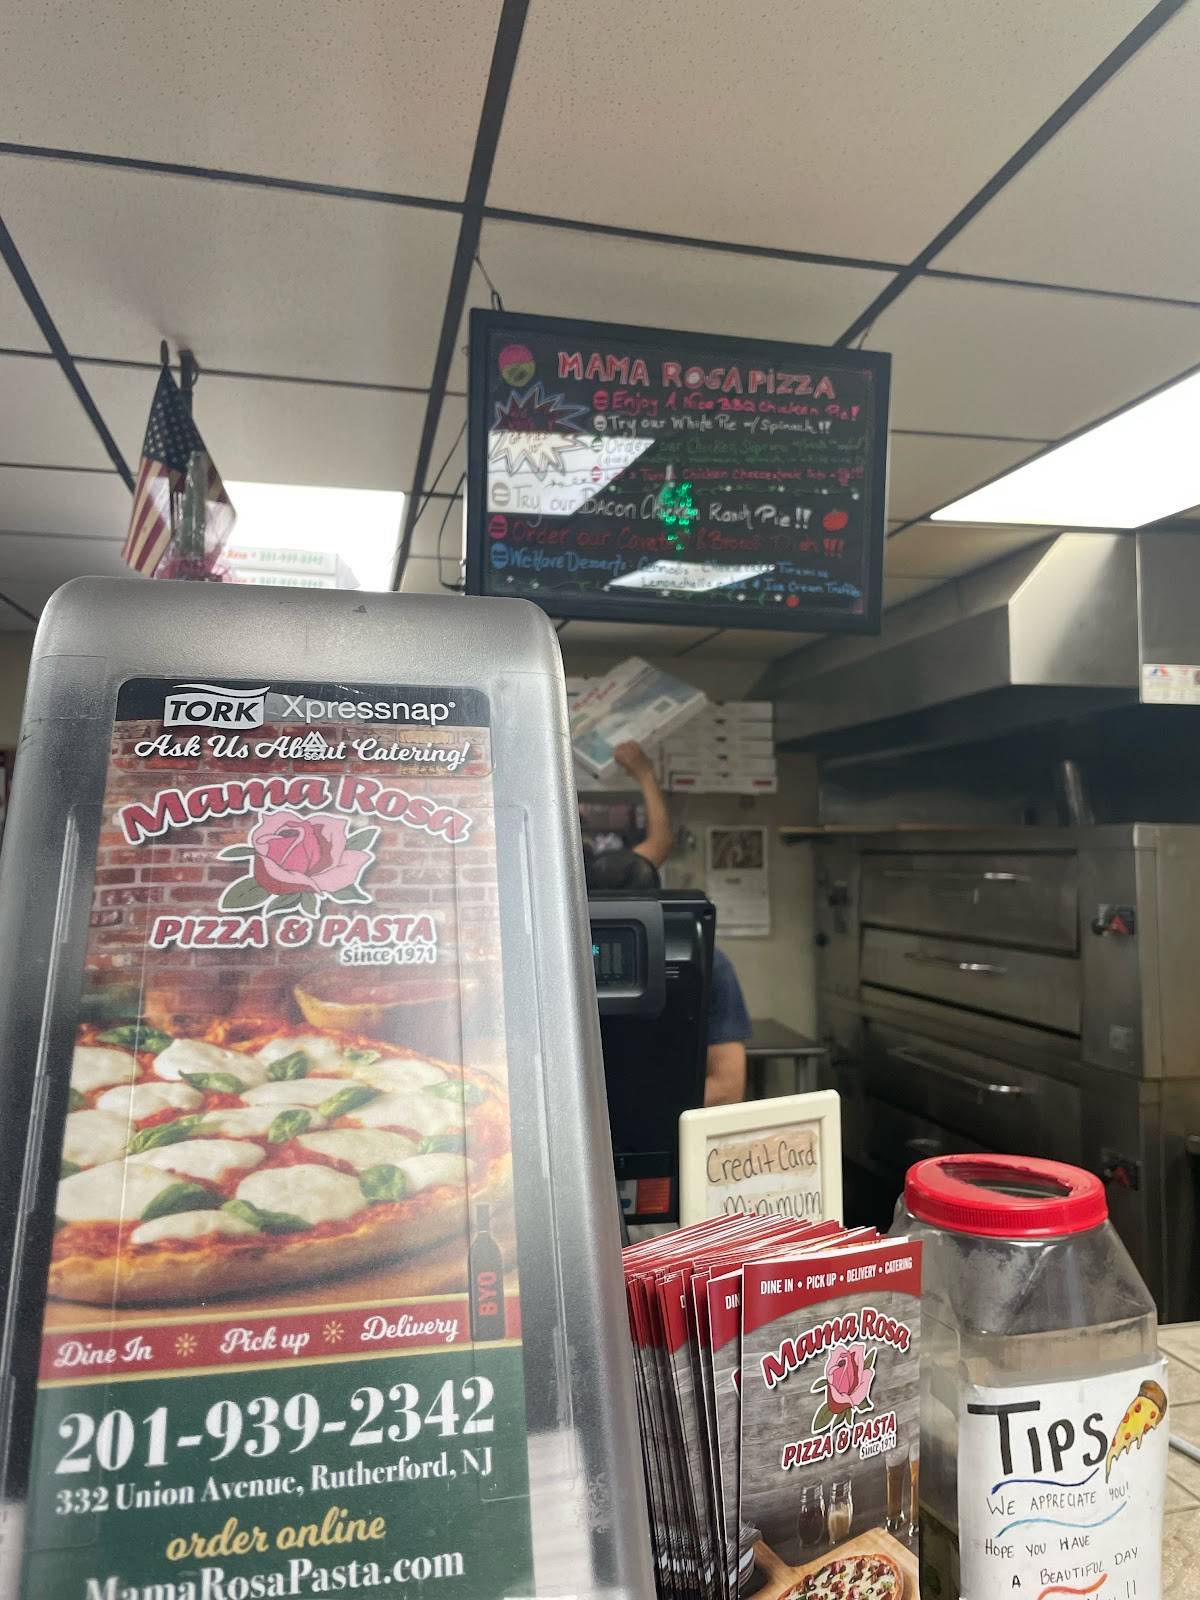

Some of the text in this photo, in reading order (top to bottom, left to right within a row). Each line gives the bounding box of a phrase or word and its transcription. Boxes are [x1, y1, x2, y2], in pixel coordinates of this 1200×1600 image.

[558, 351, 650, 387] MAMA
[661, 361, 743, 394] ROSA
[612, 390, 658, 416] Enjoy
[607, 415, 637, 437] Try
[641, 419, 664, 428] our
[671, 415, 713, 432] White
[550, 498, 577, 511] our
[512, 520, 570, 545] Order
[577, 530, 611, 545] our
[168, 699, 259, 723] TORK
[135, 735, 470, 771] Ask Us Abut Catering!
[118, 775, 472, 846] Mama Rosa
[150, 915, 437, 950] PIZZA & PASTA
[339, 947, 437, 966] Since 1971
[706, 1141, 816, 1184] Credit Card
[723, 1191, 822, 1218] Minimum
[477, 1271, 498, 1316] BYO
[760, 1256, 912, 1295] DINE IN PICK UP DELIVERY CATERING
[726, 1293, 741, 1310] DIN
[55, 1316, 459, 1367] Dine In Pick up Delivery
[761, 1307, 910, 1389] Mama Rosa
[55, 1376, 495, 1474] 201-939-2342
[782, 1411, 897, 1470] PIZZA & PASTA
[860, 1437, 897, 1458] Since 1971
[56, 1447, 493, 1515] 332 Union Avenue, Rutherford, NJ
[987, 1496, 1015, 1516] WE
[1030, 1491, 1097, 1511] APPRECIATE
[166, 1505, 387, 1561] order online
[985, 1535, 1090, 1559] HOPE YOU HAVE
[86, 1551, 465, 1600] MamaRosaPasta.com
[1011, 1547, 1138, 1589] A BEAUTIFUL DAY
